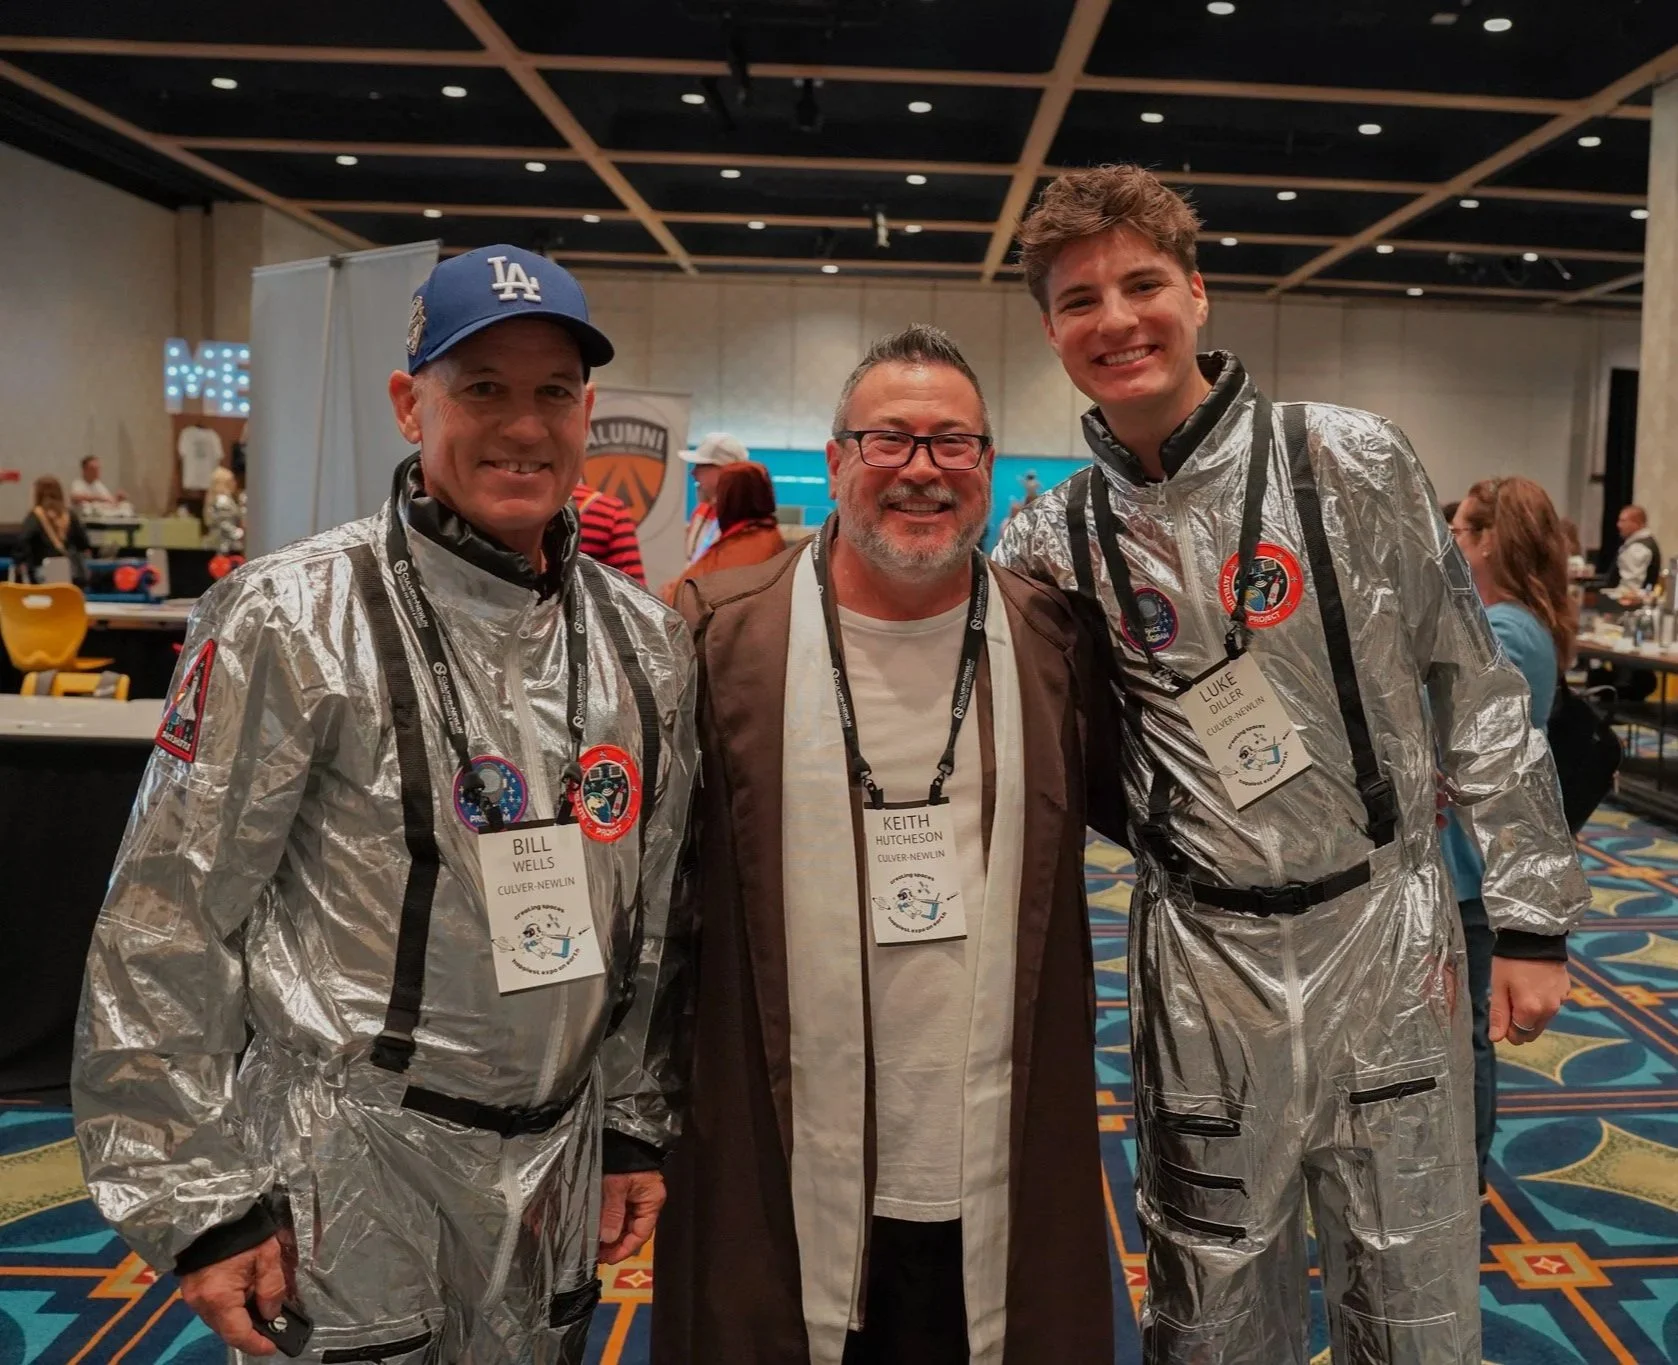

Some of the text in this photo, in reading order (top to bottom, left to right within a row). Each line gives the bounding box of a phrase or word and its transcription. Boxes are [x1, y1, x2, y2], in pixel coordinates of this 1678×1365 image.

[487, 255, 542, 303] LA
[587, 421, 665, 451] ALUMNI
[402, 572, 430, 628] CULVER-NEWLIN
[1248, 611, 1280, 623] PROJECT
[957, 658, 971, 707] CULVER-NEWLIN
[1199, 671, 1238, 703] LUKE
[1208, 687, 1244, 715] DILLER
[1206, 695, 1266, 737] CULVER-NEWLIN
[883, 813, 930, 831] KEITH
[512, 835, 552, 856] BILL
[875, 830, 943, 845] HUTCHESON
[512, 856, 555, 873] WELLS
[877, 849, 946, 863] CULVER-NEWLIN
[497, 876, 576, 896] CULVER-NEWLIN
[514, 904, 565, 920] creating spaces
